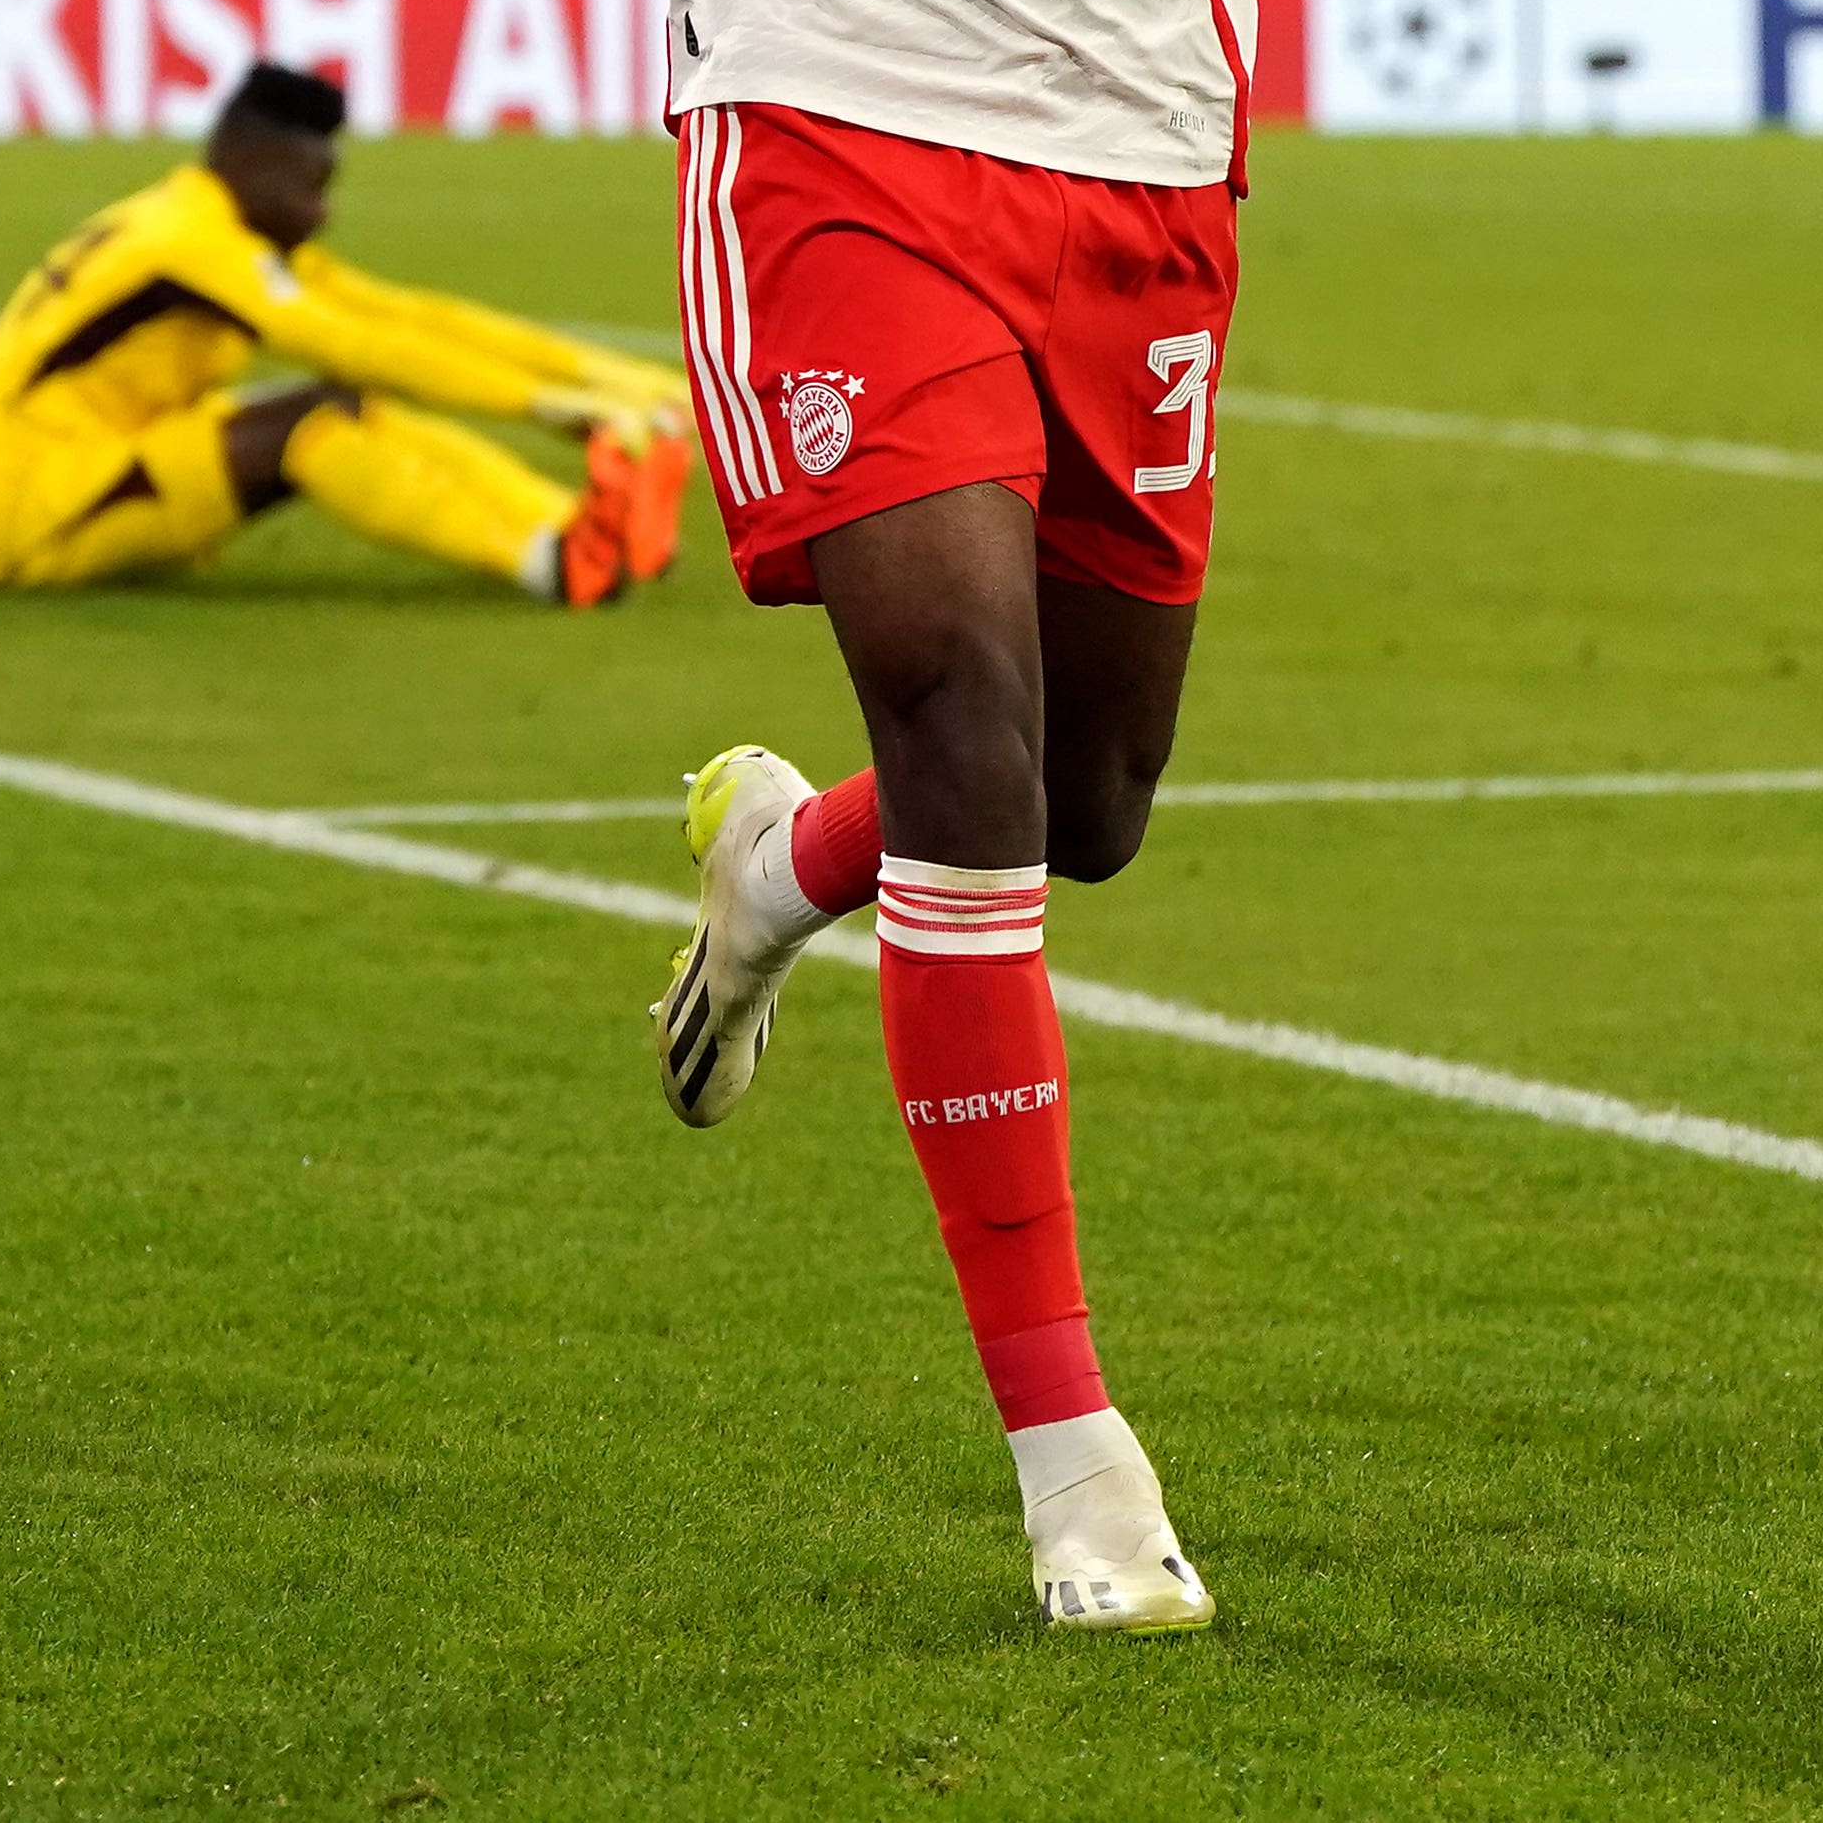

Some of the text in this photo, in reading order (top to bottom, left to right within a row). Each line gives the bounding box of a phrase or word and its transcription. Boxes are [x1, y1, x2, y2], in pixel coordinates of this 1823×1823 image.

[797, 389, 842, 417] BAYERN
[1134, 329, 1217, 495] 3
[905, 1077, 1060, 1126] FC BAYERN
